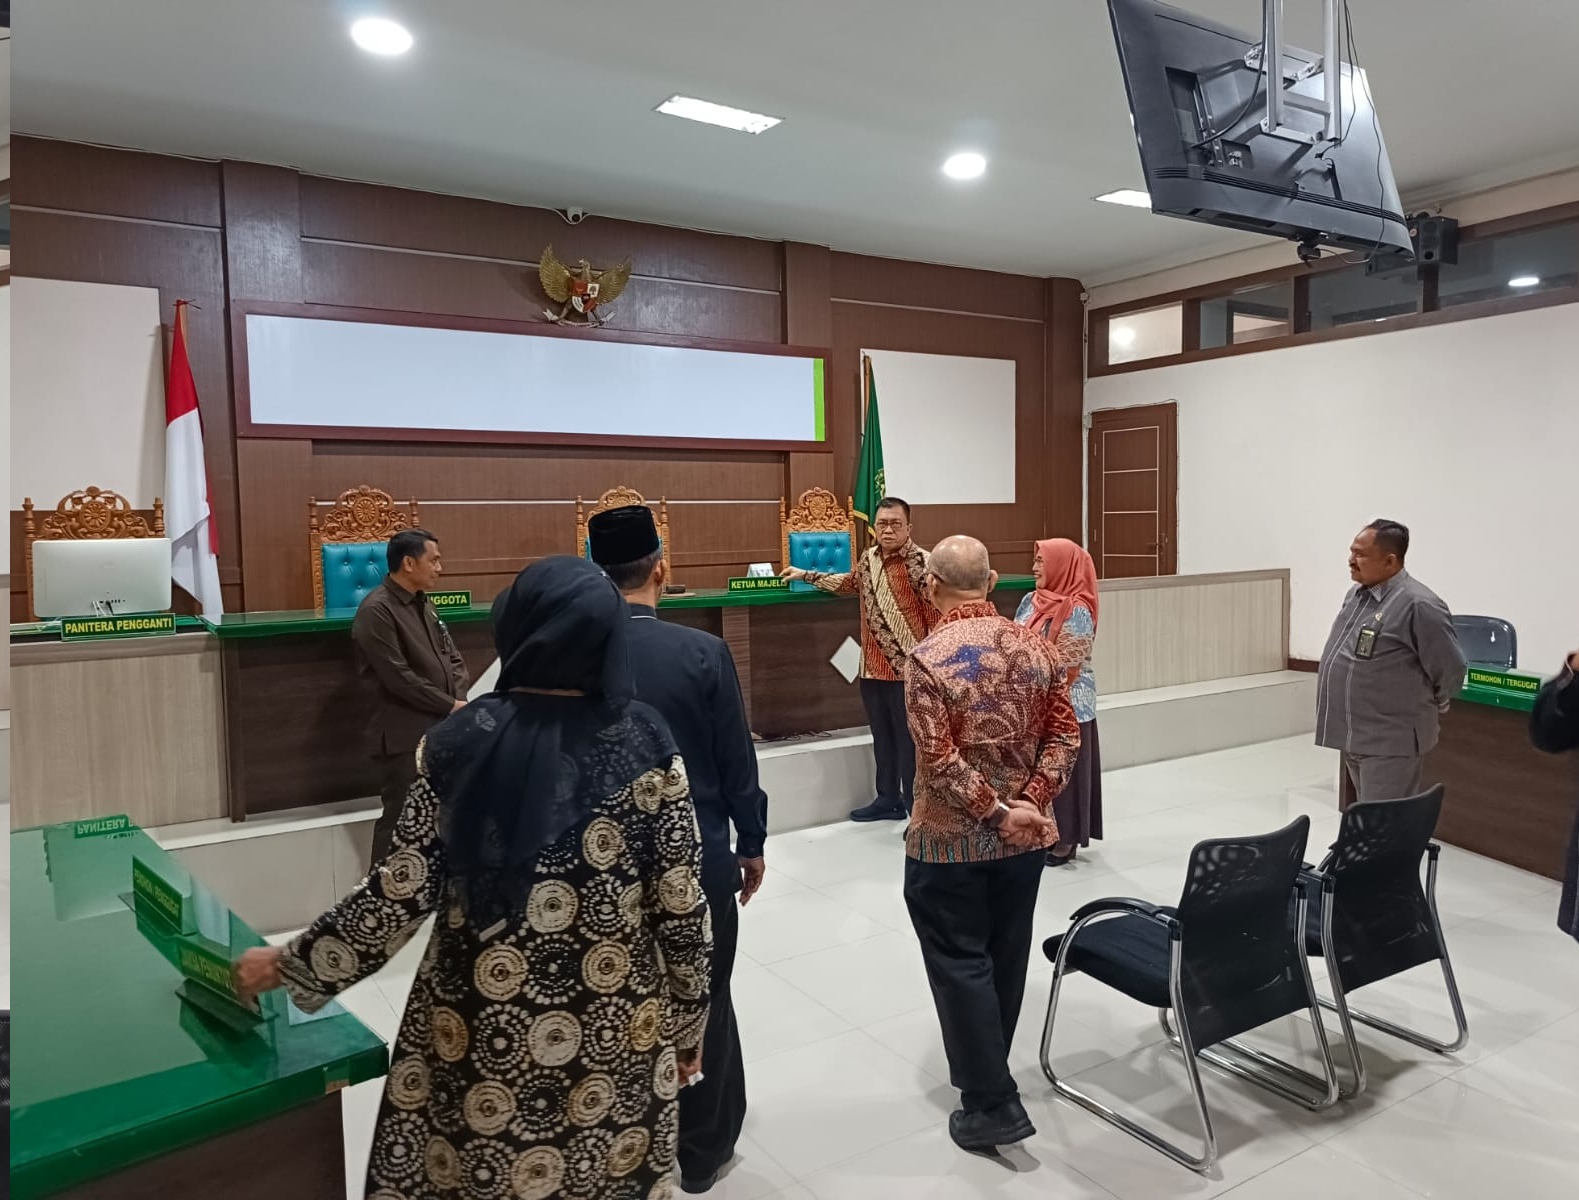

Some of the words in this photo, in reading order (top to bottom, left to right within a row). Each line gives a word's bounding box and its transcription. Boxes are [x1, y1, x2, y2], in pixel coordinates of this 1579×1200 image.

[731, 580, 756, 589] KETUA
[65, 621, 115, 634] PANITERA
[116, 618, 172, 631] PENGGANTI
[1470, 672, 1502, 685] TERMOHON
